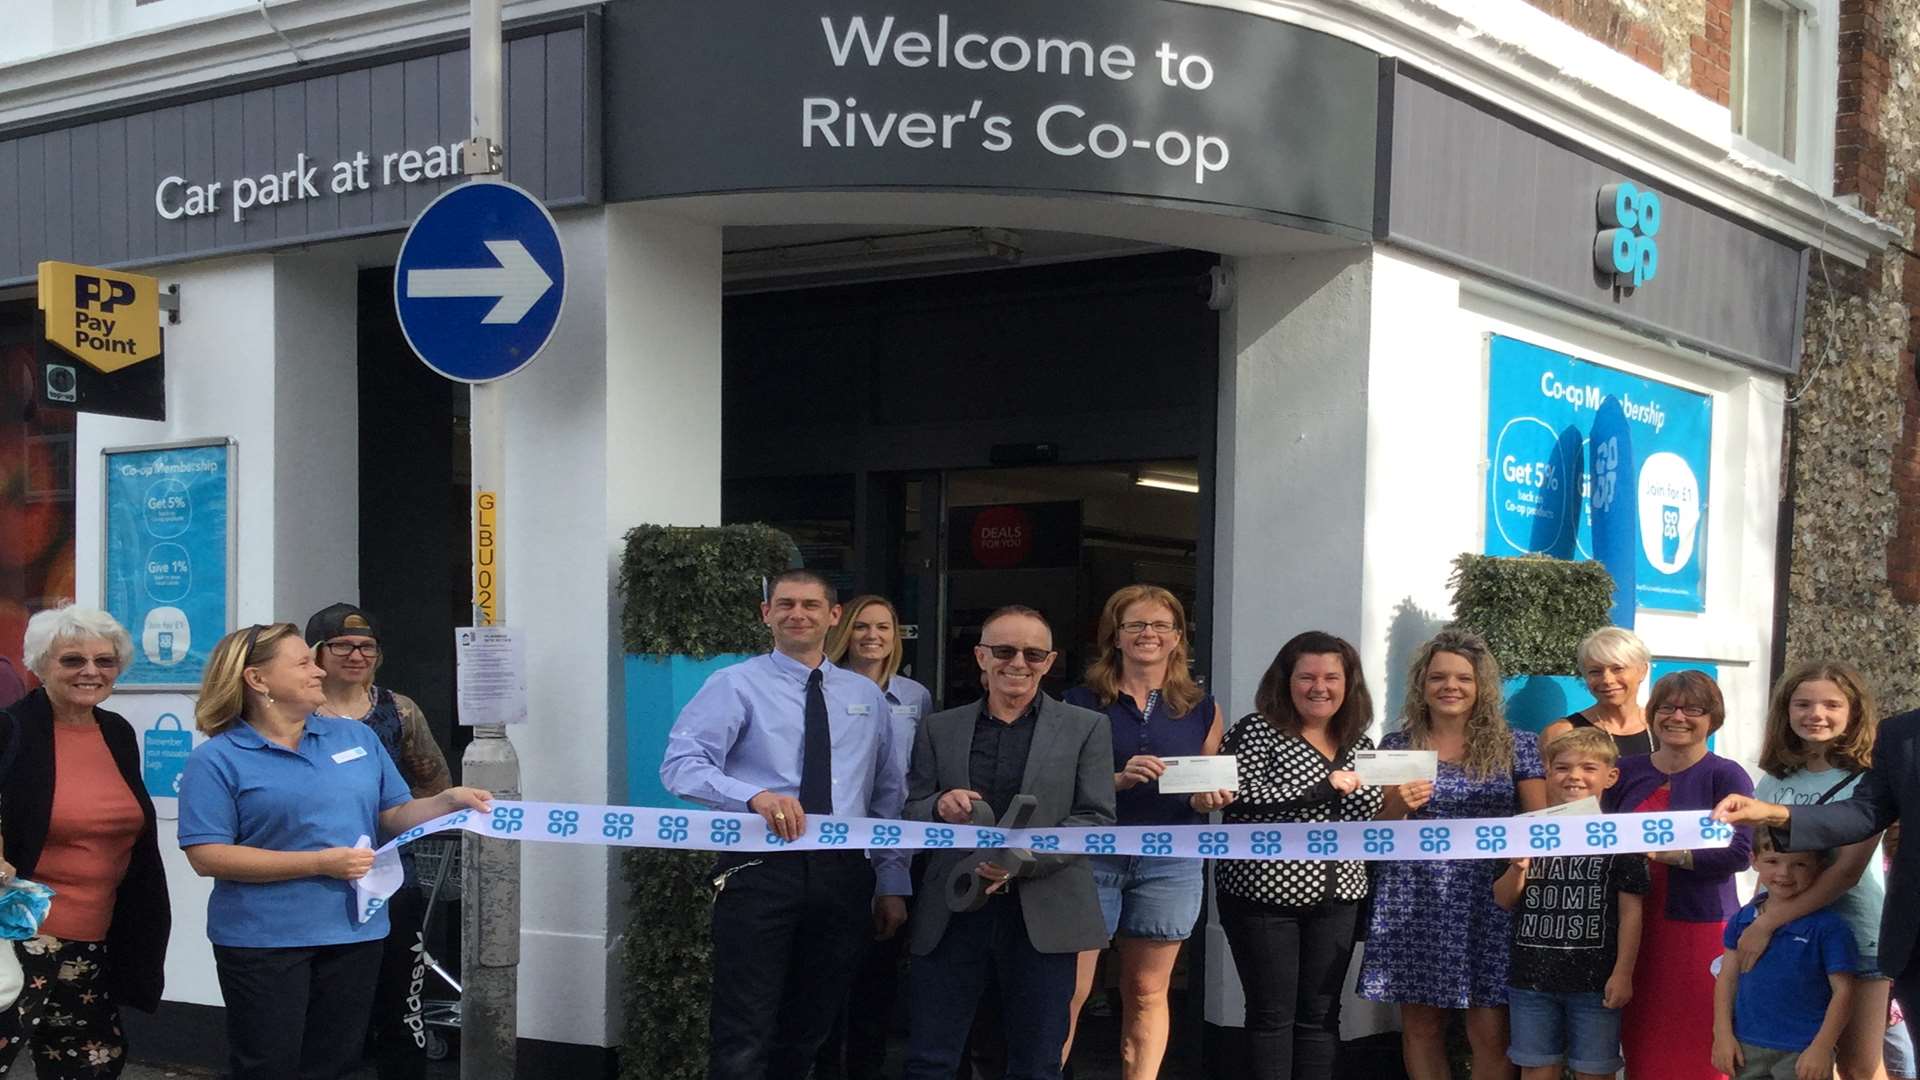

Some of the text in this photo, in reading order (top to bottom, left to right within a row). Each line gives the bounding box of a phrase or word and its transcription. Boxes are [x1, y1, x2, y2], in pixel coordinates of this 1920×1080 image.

[821, 15, 1214, 90] Welcome to
[802, 98, 1230, 184] River's Co-op
[156, 140, 464, 222] Car park at rear
[76, 311, 116, 336] Pay
[76, 330, 137, 355] Point
[1541, 371, 1664, 434] Co-op Mbership
[153, 458, 218, 474] Membership
[1503, 455, 1558, 491] Get 5%
[148, 496, 186, 510] Get 5%
[1646, 482, 1692, 502] Join for £1
[1505, 499, 1526, 516] Co-op
[981, 526, 1022, 538] DEALS
[148, 560, 188, 574] Give 1%
[1526, 857, 1604, 880] MAKE
[1525, 885, 1602, 909] SOME
[1521, 914, 1600, 939] NOISE
[403, 964, 425, 1048] adidas
